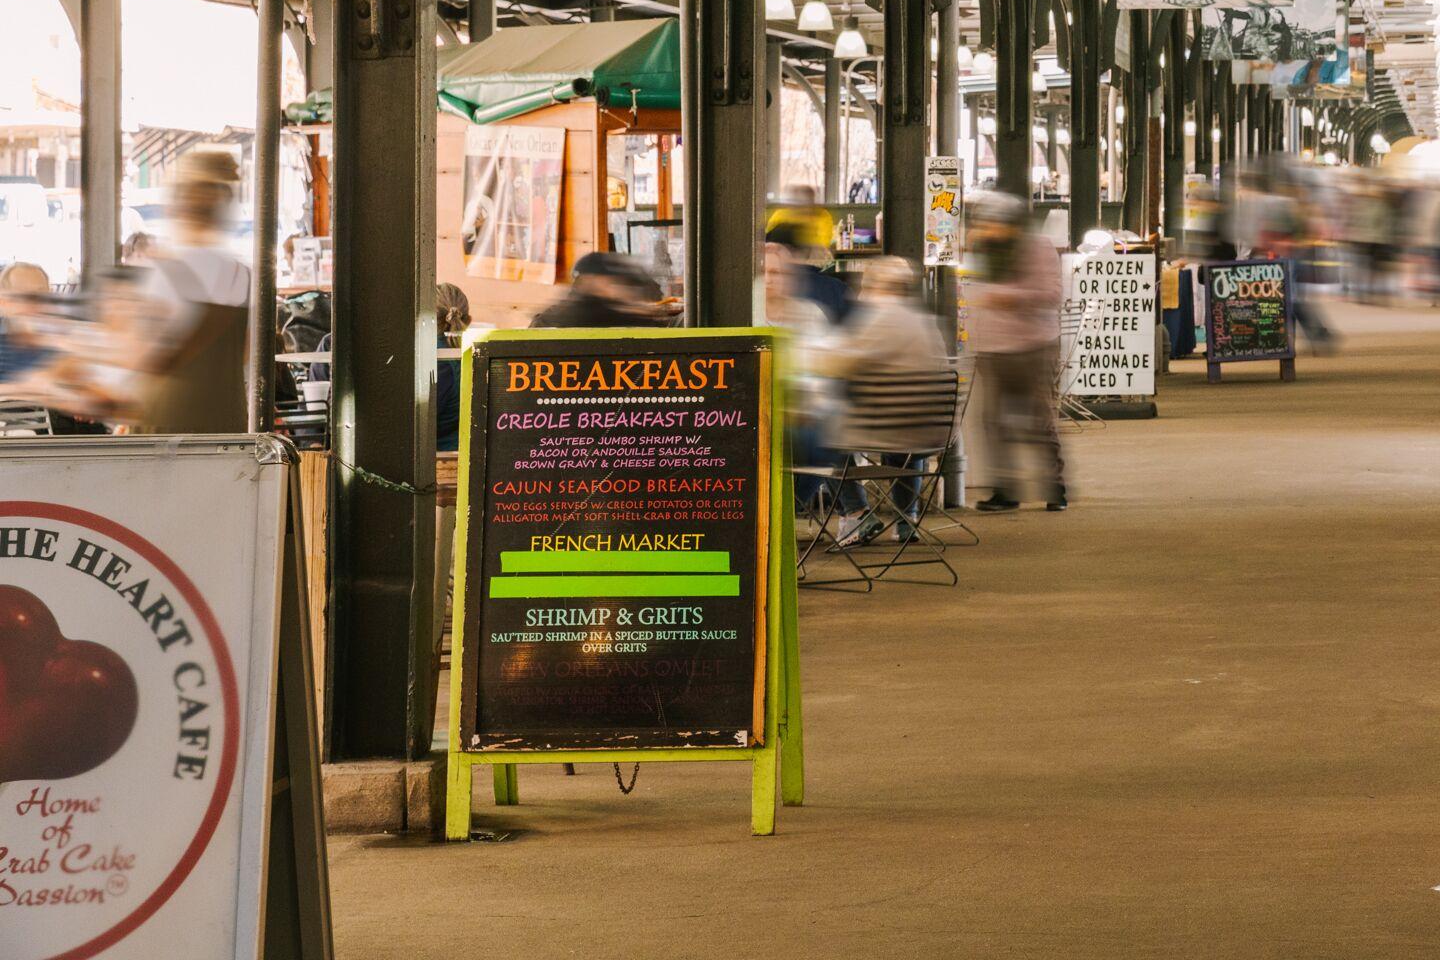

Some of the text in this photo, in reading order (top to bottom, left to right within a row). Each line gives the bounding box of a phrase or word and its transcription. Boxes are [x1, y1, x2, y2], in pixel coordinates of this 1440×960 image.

[1087, 261, 1144, 275] FROZEN
[1236, 264, 1284, 282] SEAFOOD
[1080, 280, 1138, 294] OR ICED
[1238, 280, 1284, 298] DOCK
[1085, 336, 1125, 350] BASIL
[506, 358, 735, 392] BREAKFAST
[1084, 373, 1134, 387] ICED T
[496, 410, 747, 430] CREOLE BREAKFAST BOWL
[540, 435, 701, 446] SAU'TEED JUMBO SHRIMP W/
[530, 447, 712, 458] BACON OR ANDOUILLE SAUSAGE
[514, 458, 726, 470] BROWN GRAVY & CHEESE OVER GRITS
[493, 478, 746, 495] CAJUN SEAFOOD BREAKFAST
[496, 500, 743, 511] TWO EGGS SERVED W/ CREOLE POTATOS OR GRITS
[493, 511, 744, 523] ALLIGATOR MEAT SOFT SHELL CRAB OR FROG LEGS
[530, 533, 705, 552] FRENCH MARKET
[526, 607, 703, 627] SHRIMP & GRITS
[491, 630, 737, 643] SAU'TEED SHRIMP IN A SPICED BUTTER SAUCE
[582, 642, 647, 653] OVER GRITS
[66, 538, 193, 653] HEART
[173, 660, 210, 780] CAFE
[16, 786, 101, 817] Home
[42, 814, 73, 849] of
[60, 844, 136, 875] Cake
